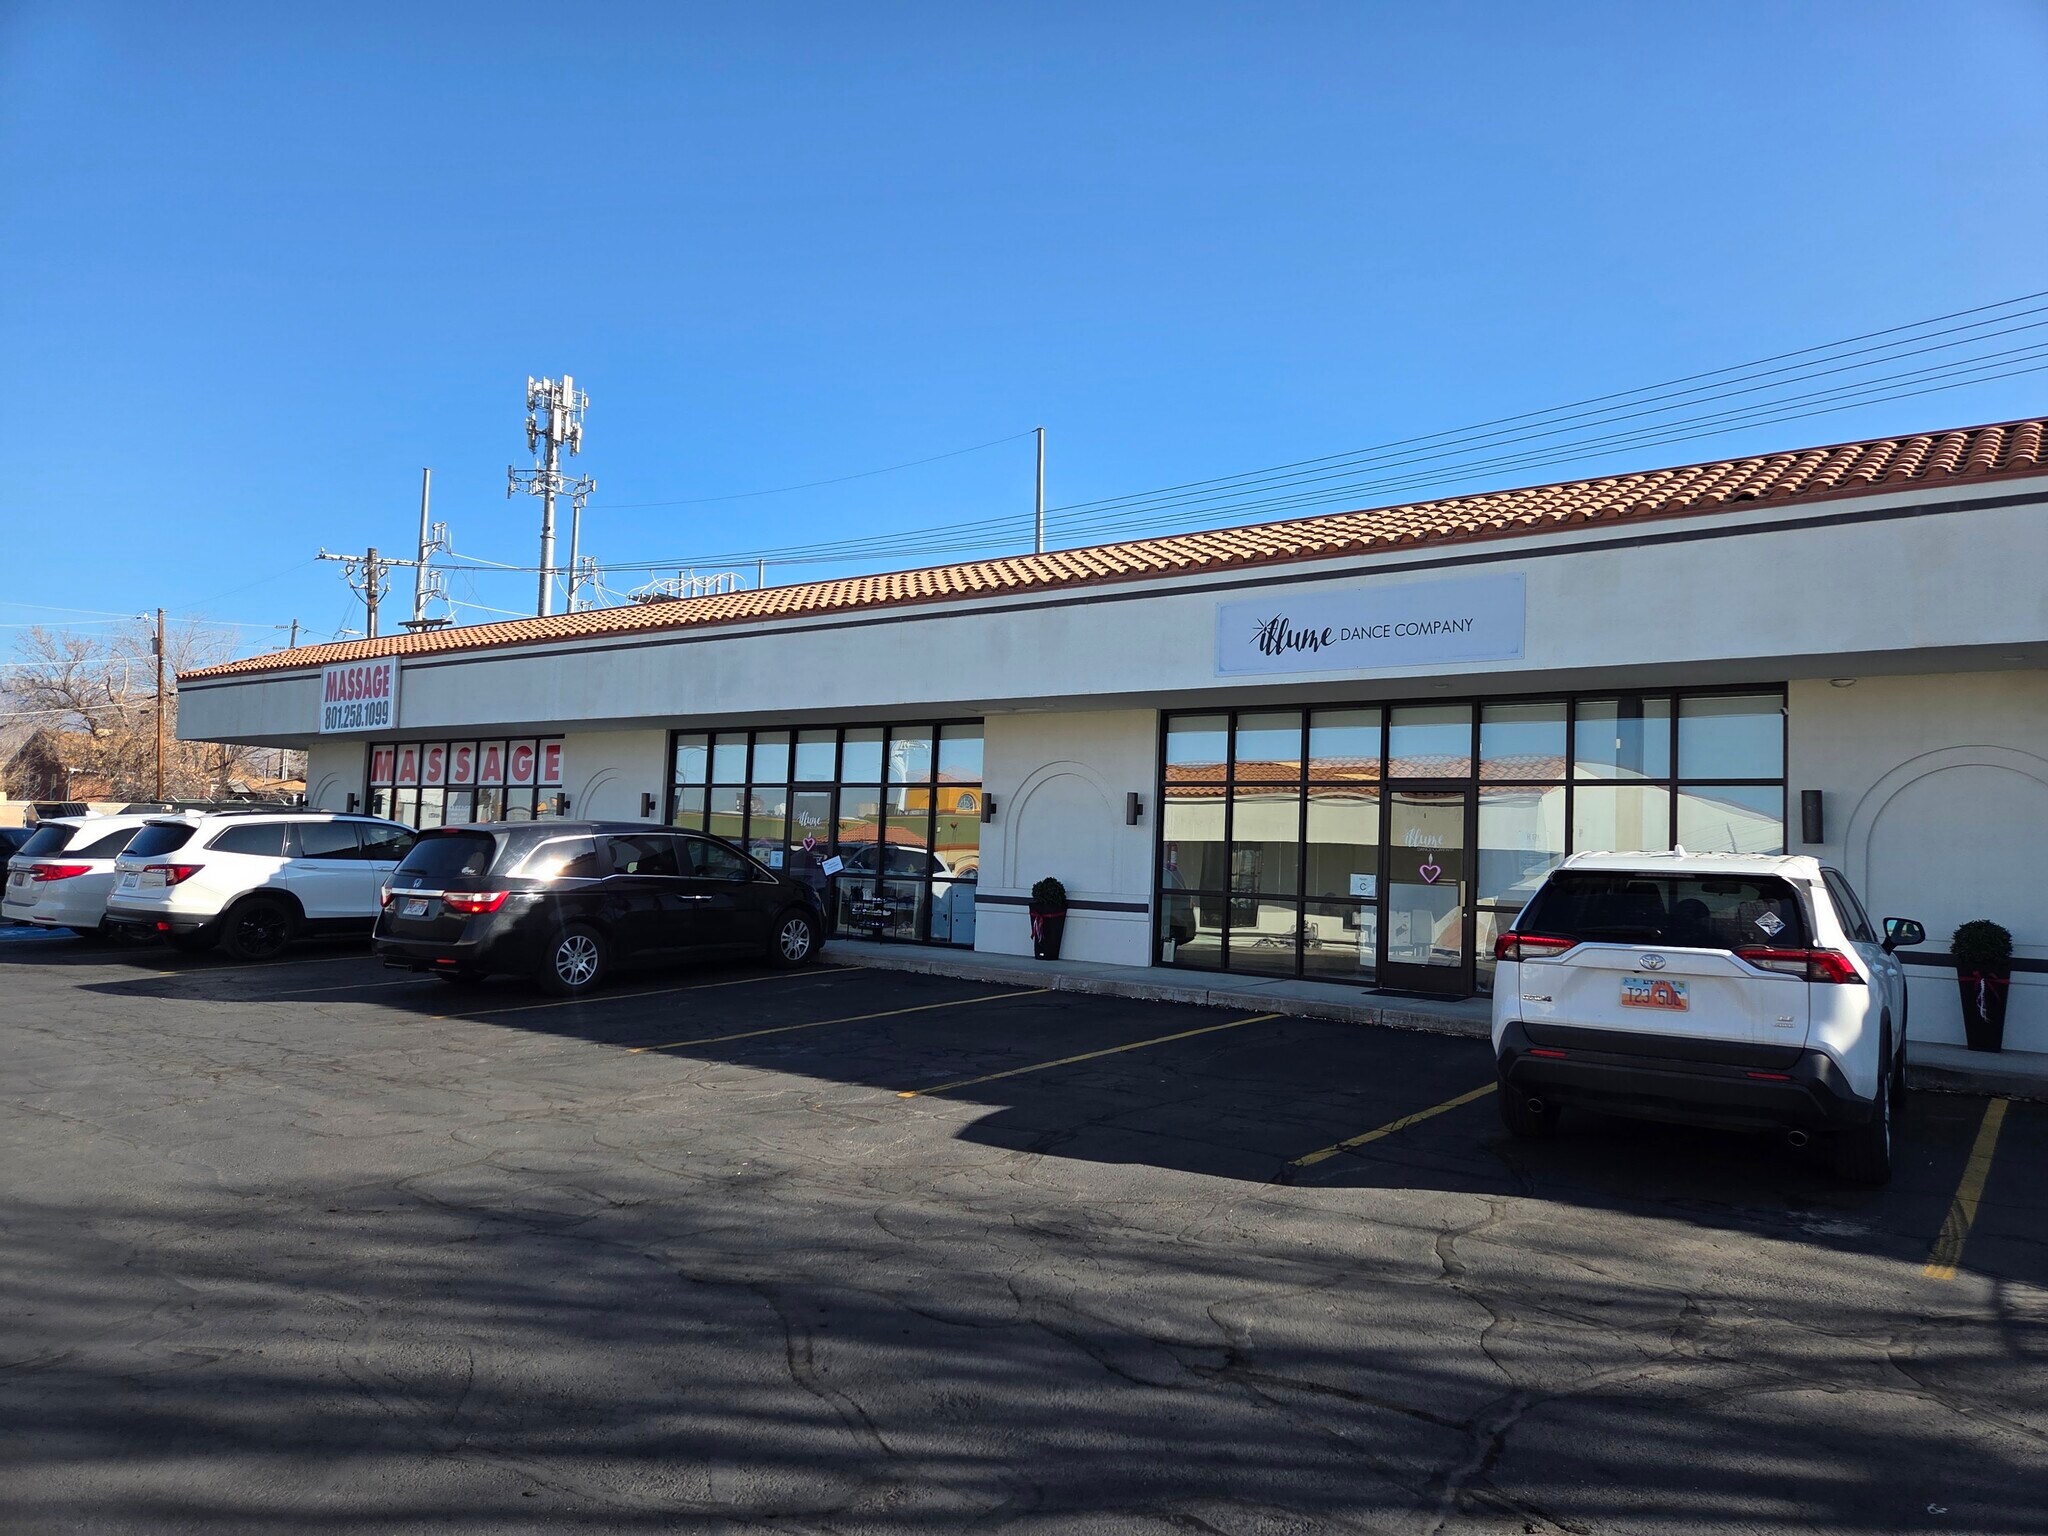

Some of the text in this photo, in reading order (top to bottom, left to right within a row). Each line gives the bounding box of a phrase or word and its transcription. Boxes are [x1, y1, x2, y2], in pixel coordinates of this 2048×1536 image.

[1250, 613, 1474, 656] illume DANCE COMPANY
[324, 664, 390, 703] MASSAGE
[324, 700, 389, 730] 801.258.1099
[371, 744, 561, 782] MASSAGE
